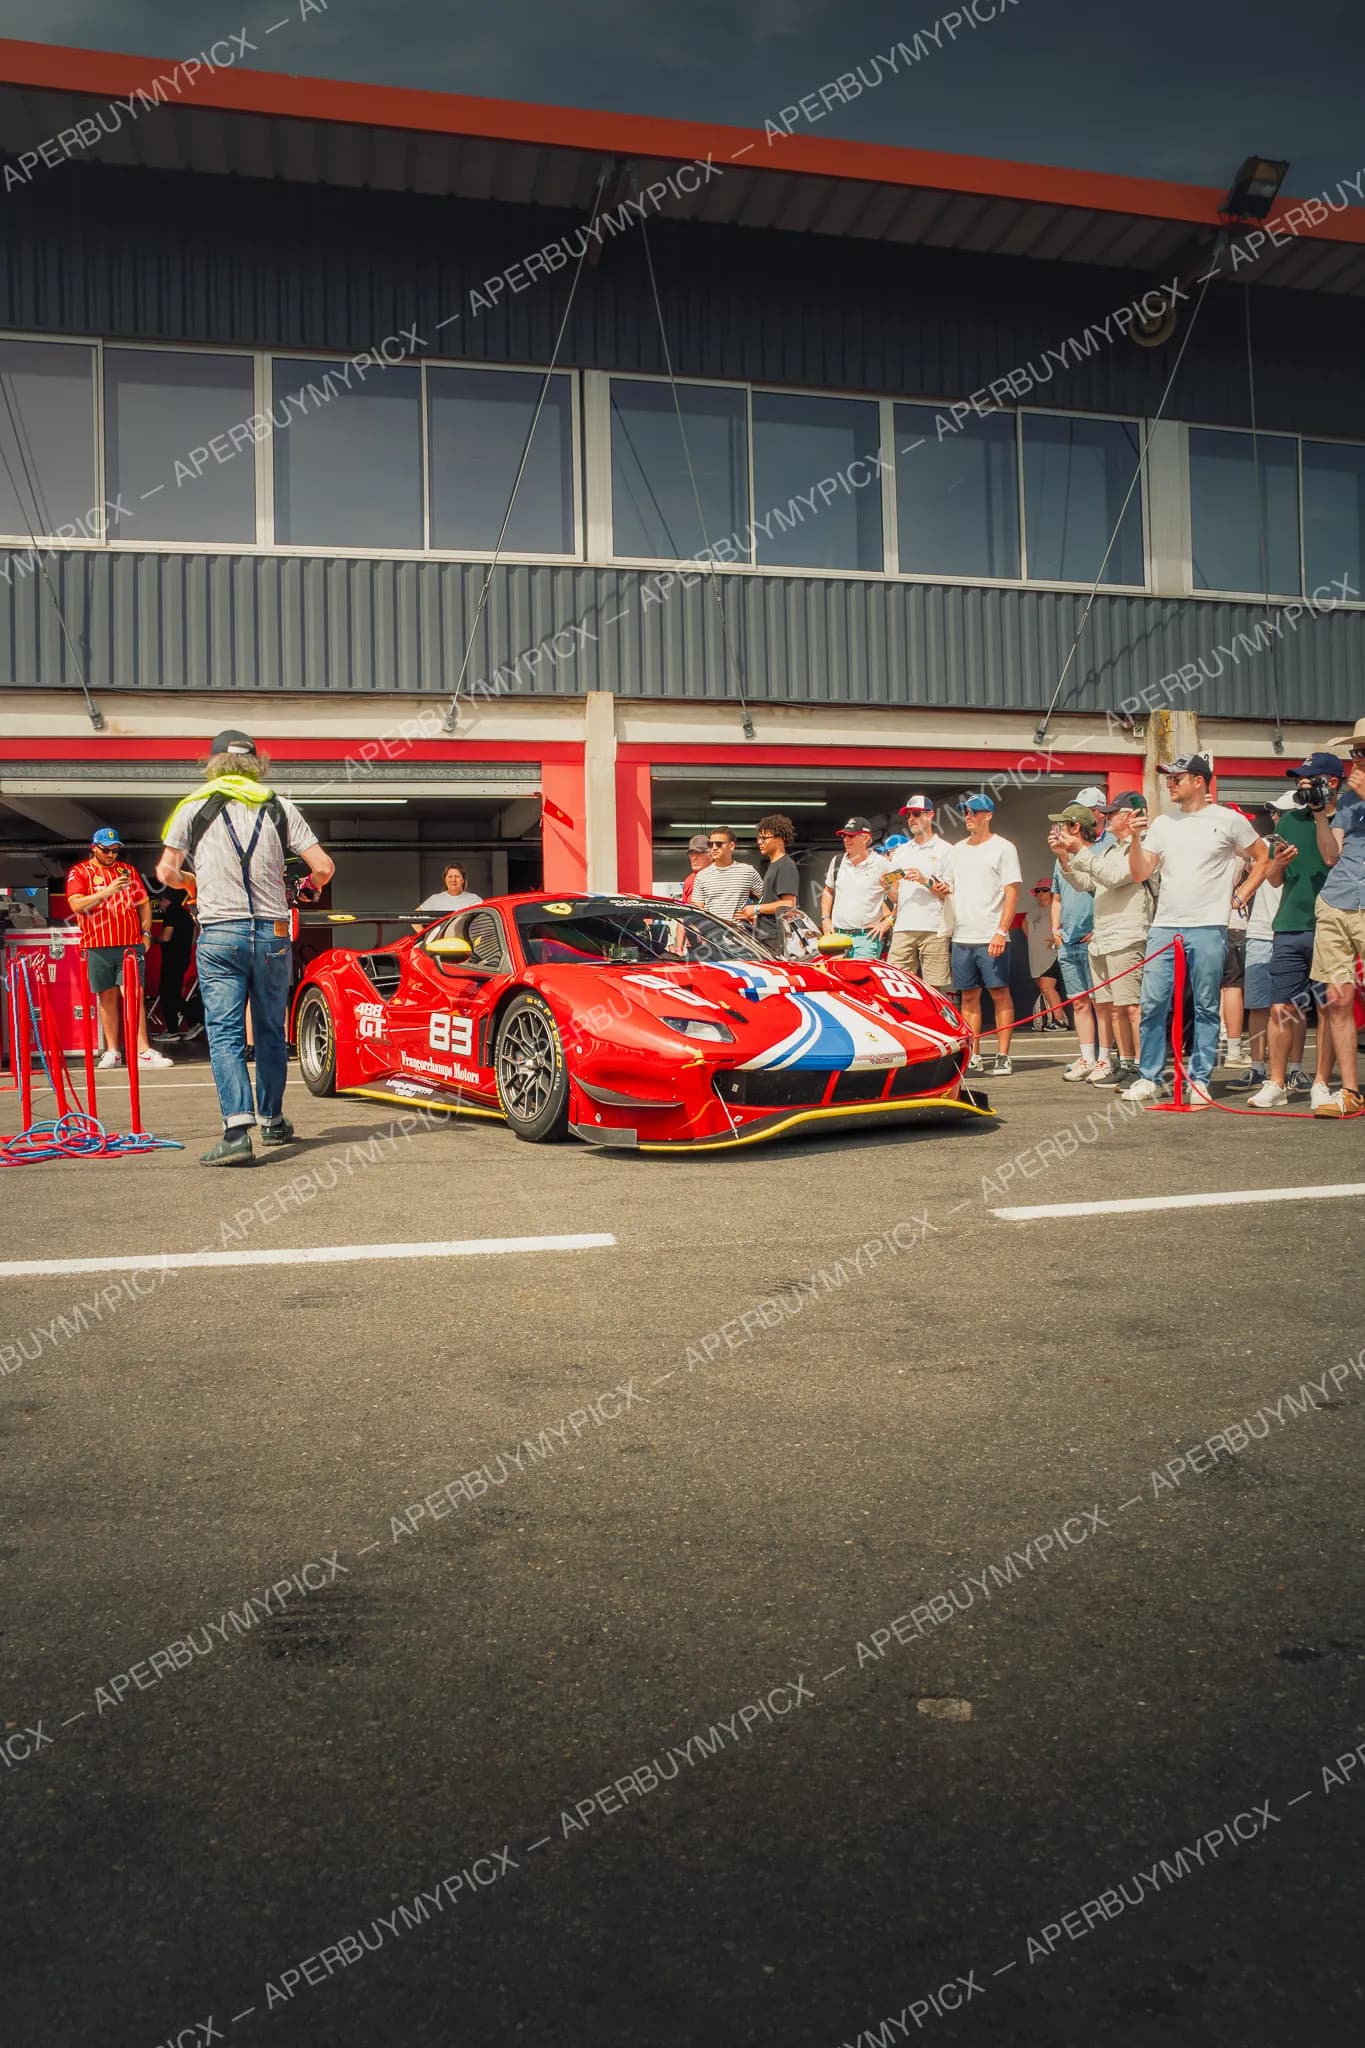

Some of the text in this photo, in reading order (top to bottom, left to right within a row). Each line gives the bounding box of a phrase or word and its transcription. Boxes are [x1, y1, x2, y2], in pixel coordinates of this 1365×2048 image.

[870, 966, 923, 1000] 83
[355, 1002, 384, 1017] 488
[360, 1015, 387, 1039] GT
[429, 1012, 473, 1056] 83
[453, 1062, 480, 1084] Motors
